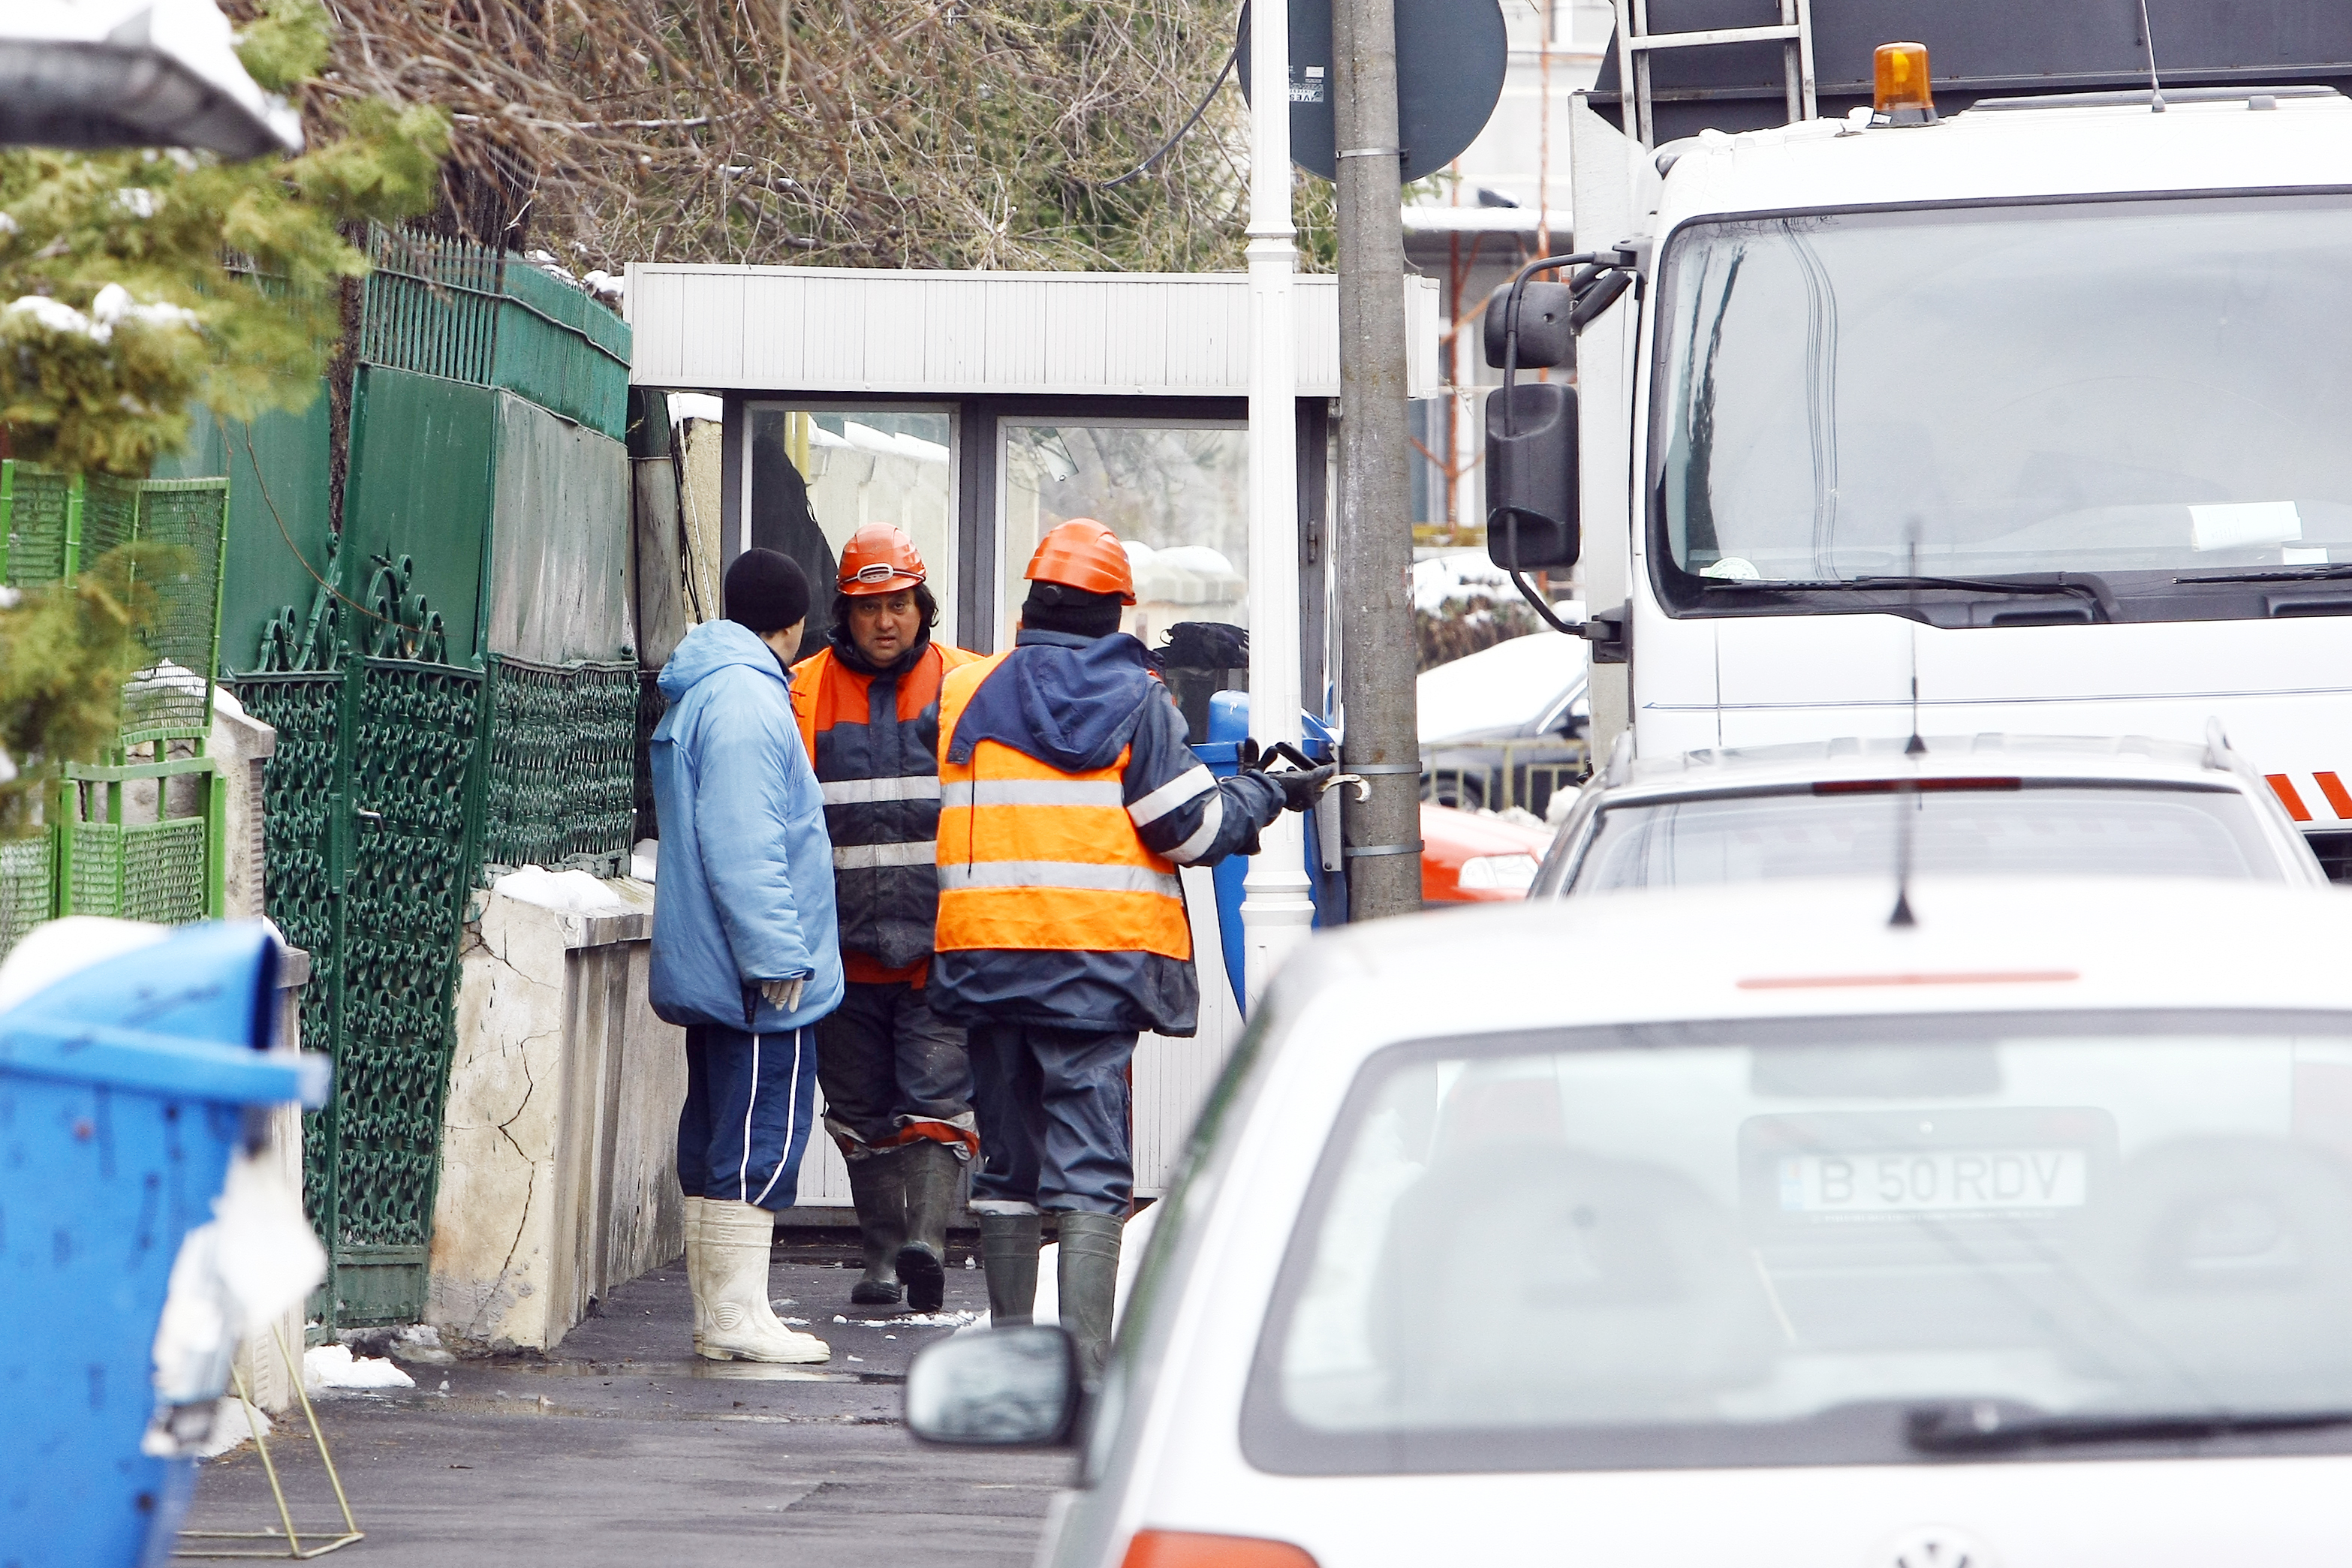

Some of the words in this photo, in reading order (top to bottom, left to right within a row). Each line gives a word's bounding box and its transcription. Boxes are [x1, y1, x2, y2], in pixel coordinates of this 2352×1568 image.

[1820, 1159, 1855, 1203] B
[1878, 1156, 1938, 1202] 50
[1953, 1154, 2064, 1201] RDV
